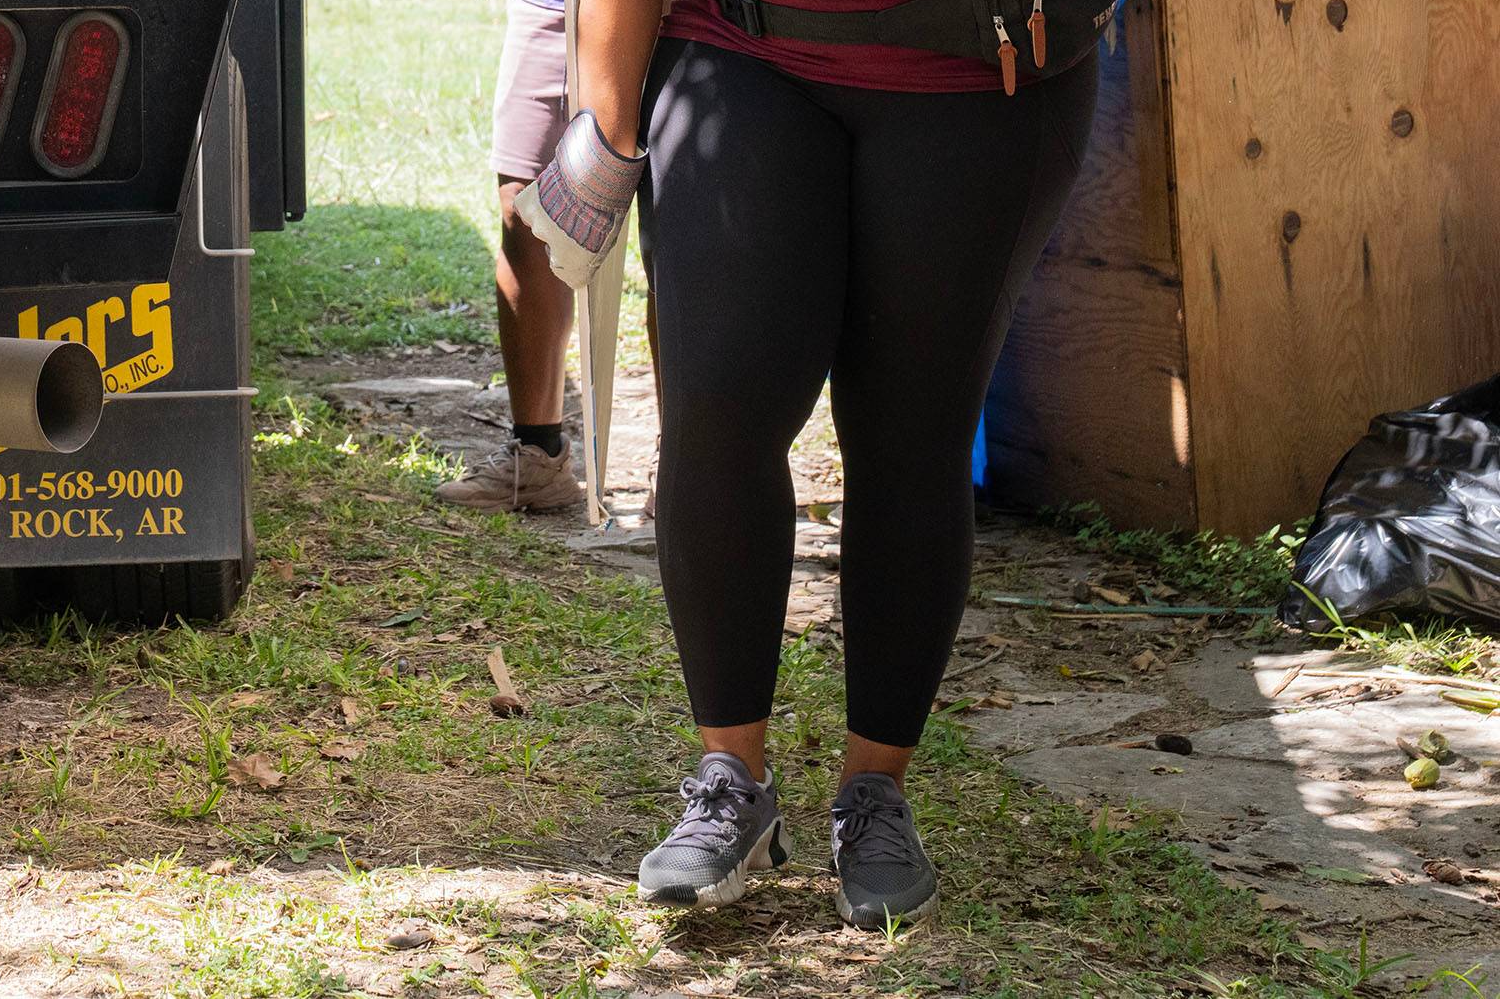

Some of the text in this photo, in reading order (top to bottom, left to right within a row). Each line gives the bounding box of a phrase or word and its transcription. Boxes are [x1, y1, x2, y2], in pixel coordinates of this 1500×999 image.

[129, 354, 164, 383] INC.
[8, 508, 123, 543] ROCK,
[135, 506, 187, 536] AR
